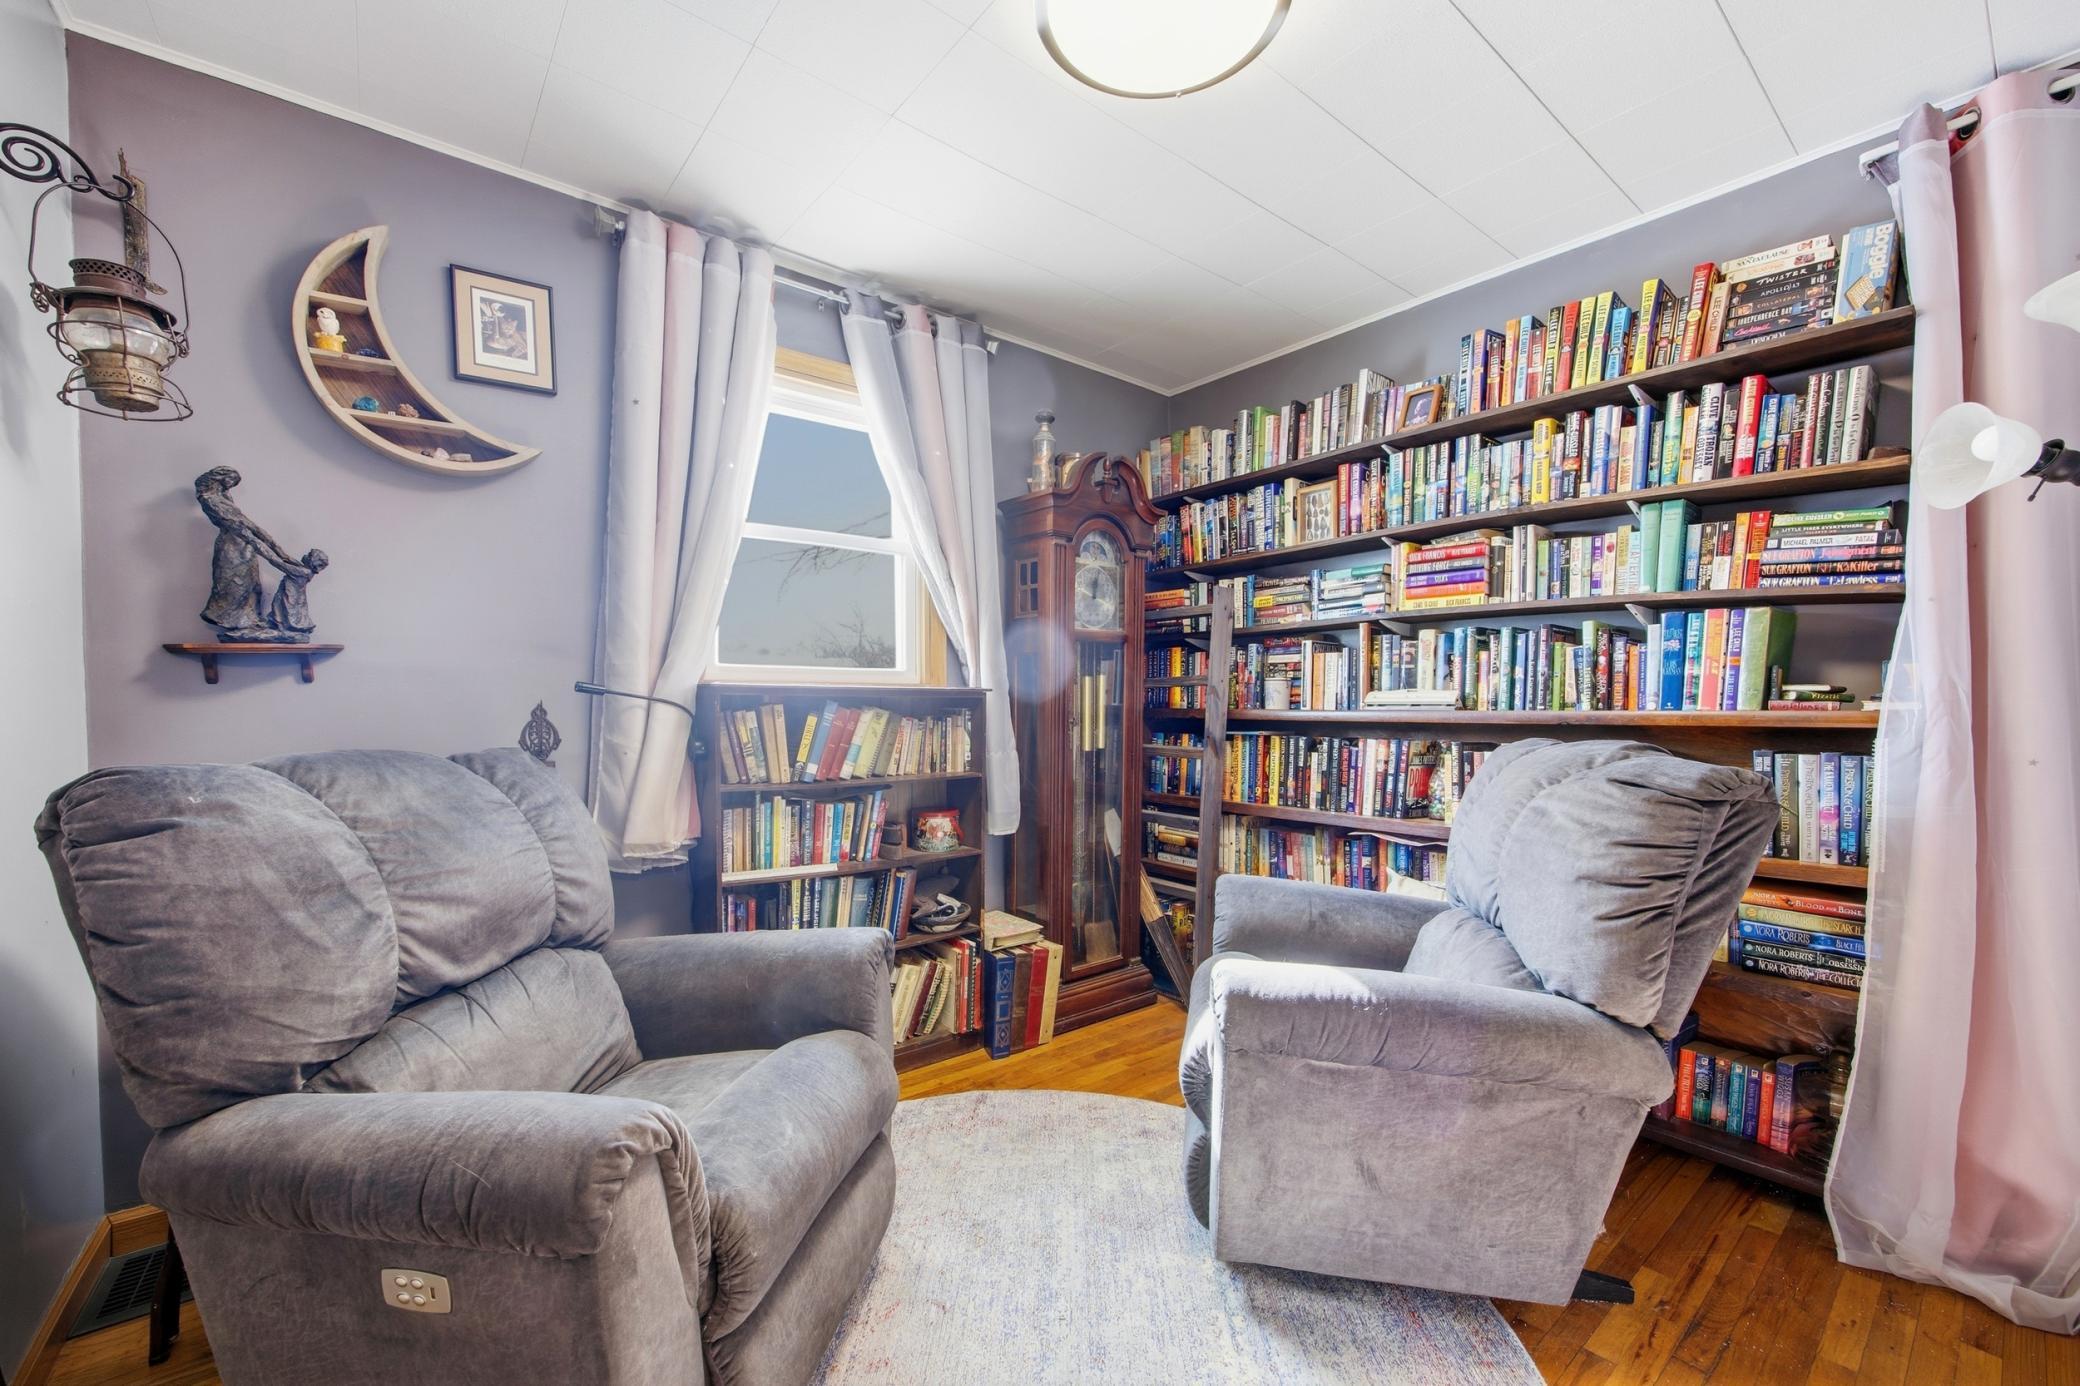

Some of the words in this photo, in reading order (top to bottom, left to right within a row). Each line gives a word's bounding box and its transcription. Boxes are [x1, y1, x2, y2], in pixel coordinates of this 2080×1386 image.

[1868, 223, 1894, 279] Boggle
[1696, 277, 1705, 290] LEE
[1756, 268, 1808, 286] TWISTER
[1644, 291, 1653, 302] LEE
[1760, 283, 1792, 297] APOLLO
[1690, 290, 1703, 309] CHILD
[1714, 296, 1722, 310] LEE
[1582, 309, 1591, 321] LEE
[1598, 304, 1607, 315] LEE
[1642, 303, 1651, 323] CHILD
[1738, 309, 1779, 325] INDEPENDENCE
[1780, 307, 1793, 317] DAY
[1550, 319, 1558, 329] LEE
[1580, 321, 1590, 339] CHILD
[1595, 316, 1605, 335] CHILD
[1614, 321, 1623, 332] LEE
[1710, 310, 1720, 333] CHILD
[1519, 338, 1528, 355] CHILD
[1548, 331, 1557, 348] CHILD
[1613, 332, 1622, 346] CHILD
[1708, 395, 1720, 418] CLIVE
[1695, 438, 1705, 470] ODYSSEY
[1703, 436, 1716, 466] TROJAN
[1821, 523, 1864, 531] EVERYWHERE
[1783, 539, 1808, 547] MICHAEL
[1809, 537, 1833, 546] PALMER
[1855, 535, 1875, 543] FATAL
[1776, 549, 1815, 560] GRAFTON
[1761, 564, 1776, 576] SUE
[1777, 563, 1812, 575] GRAFTON
[1849, 561, 1878, 572] Killer
[1779, 576, 1820, 587] GRAFTON
[1840, 575, 1878, 585] Lawless
[1735, 627, 1743, 637] LEE
[1734, 638, 1742, 652] CHILD
[1780, 769, 1790, 798] PRESTON
[1844, 768, 1856, 798] PRESTON
[1804, 798, 1814, 819] CHILD
[1823, 791, 1834, 814] PROJECT
[1780, 807, 1789, 831] CHILD
[1843, 805, 1854, 829] CHILD
[1753, 892, 1776, 900] NORA
[1795, 900, 1825, 911] BLOOD
[1838, 906, 1864, 917] BONE
[1755, 924, 1775, 938] NORA
[1777, 927, 1811, 944] ROBERTS
[1832, 921, 1861, 936] SEARCH
[1756, 945, 1778, 956] NORA
[1779, 947, 1814, 961] ROBERTS
[1758, 960, 1778, 973] NORA
[1780, 964, 1809, 978] ROBERTS
[1828, 959, 1865, 972] OBSESSIO
[1776, 1074, 1785, 1099] WIGGS
[1784, 1076, 1793, 1101] SUSAN
